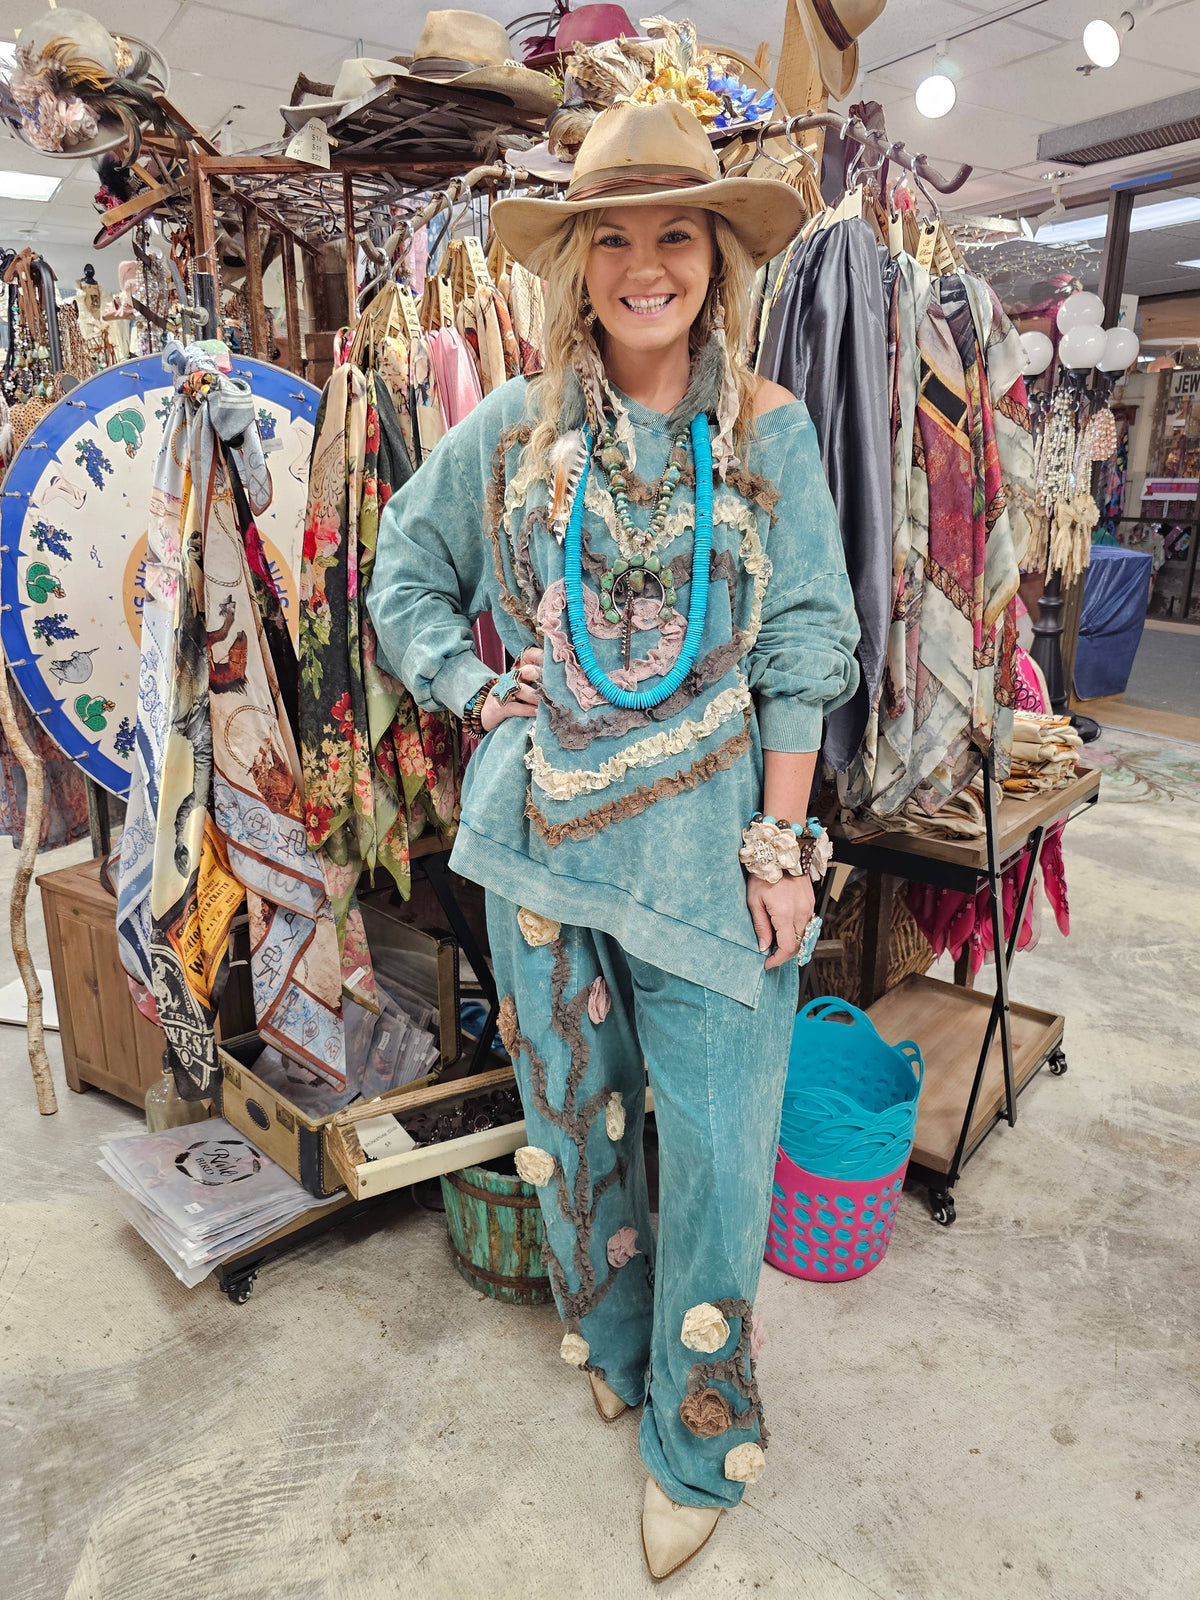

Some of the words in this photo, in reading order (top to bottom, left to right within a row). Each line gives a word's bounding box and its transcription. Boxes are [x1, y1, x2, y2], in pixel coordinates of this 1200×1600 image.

[1174, 374, 1200, 394] JEW
[208, 882, 230, 903] CRAFTS
[168, 1011, 197, 1027] TEXAS
[166, 1025, 215, 1063] WEST
[195, 1156, 214, 1175] BIRD
[202, 1148, 239, 1177] Rare
